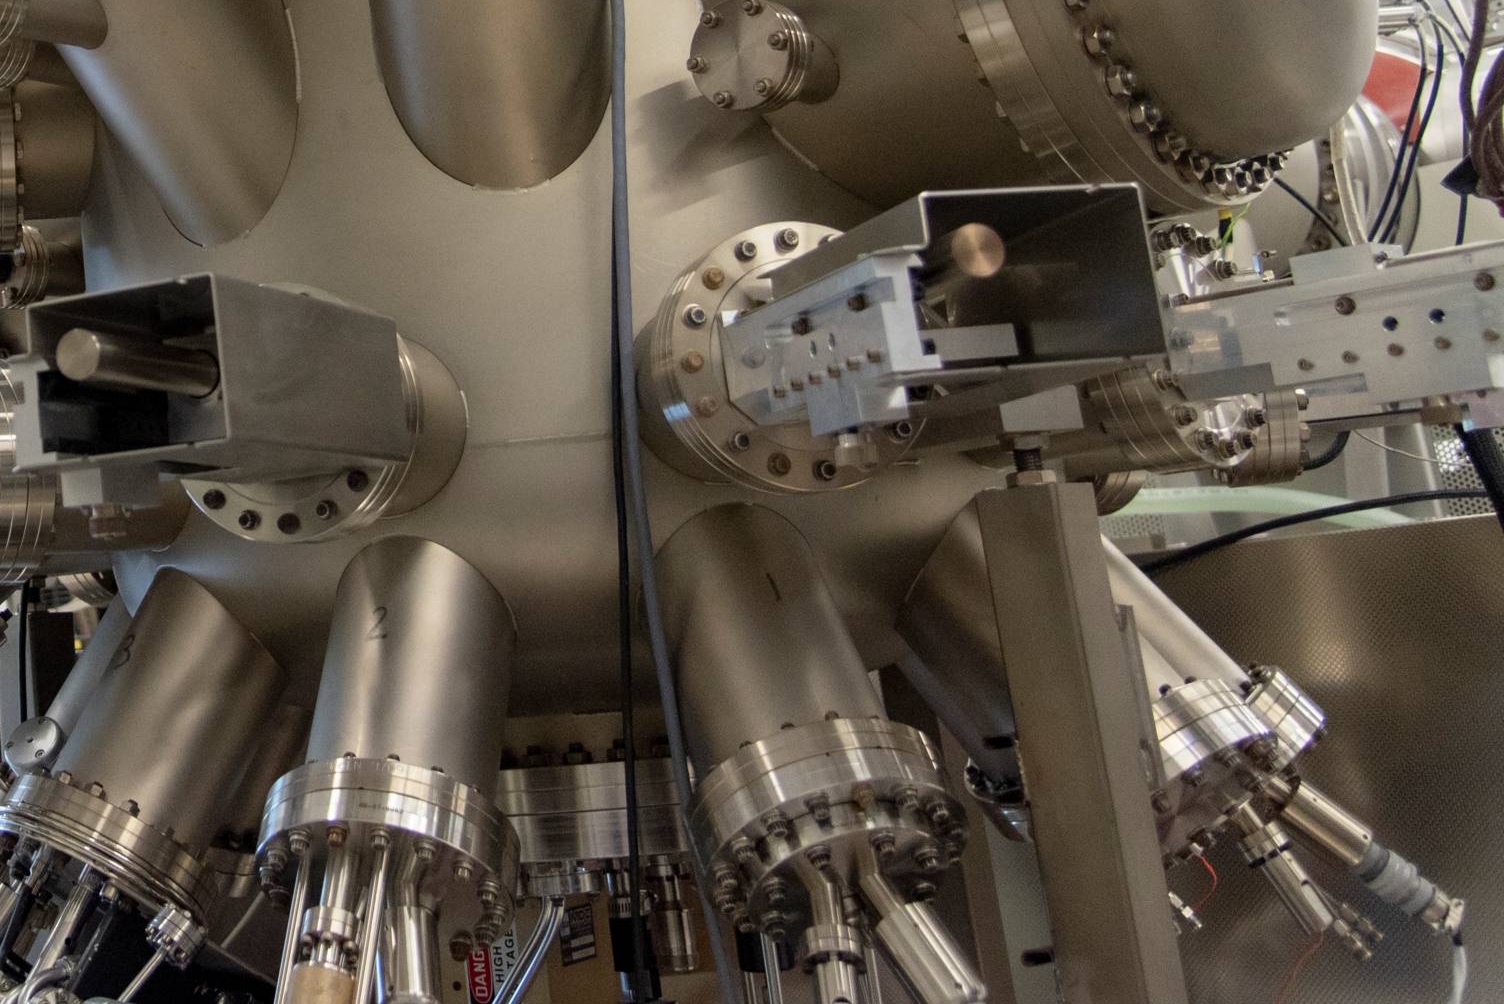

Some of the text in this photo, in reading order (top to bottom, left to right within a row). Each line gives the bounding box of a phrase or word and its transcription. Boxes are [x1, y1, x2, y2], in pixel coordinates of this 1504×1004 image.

[367, 605, 388, 640] 2
[493, 946, 504, 983] HIGH
[504, 929, 515, 969] TAGE
[472, 947, 488, 997] DANG
